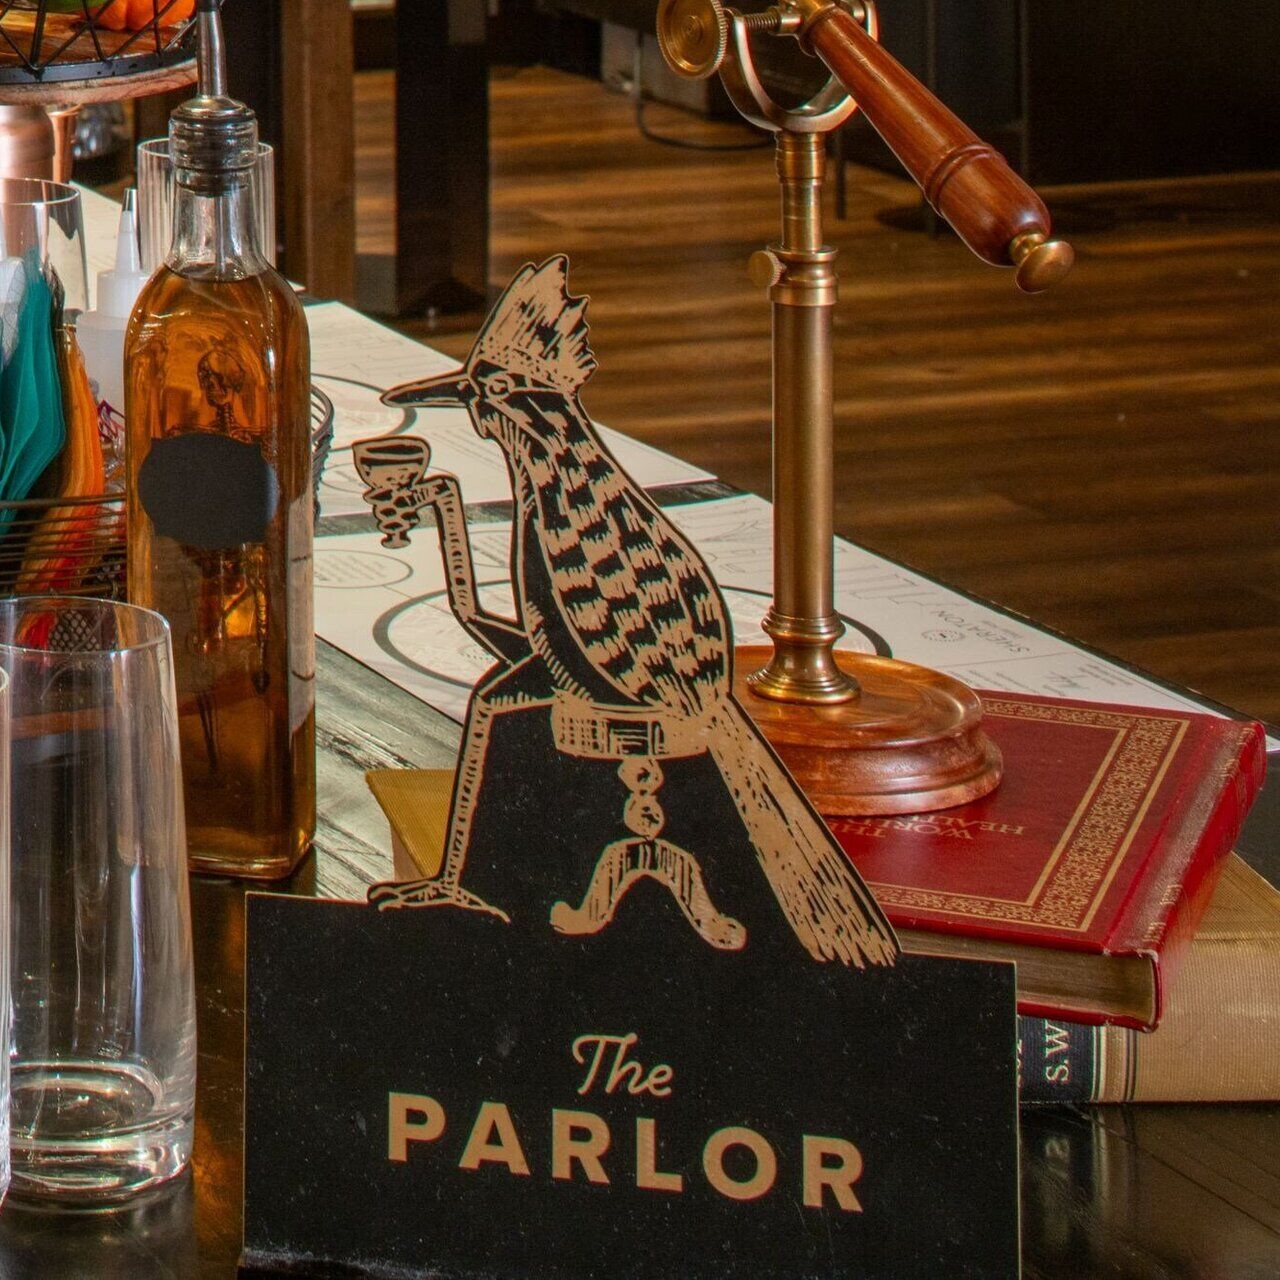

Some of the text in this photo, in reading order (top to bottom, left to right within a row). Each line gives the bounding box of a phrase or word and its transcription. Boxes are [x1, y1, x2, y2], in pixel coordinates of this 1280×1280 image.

[929, 609, 1032, 655] SHERATON
[571, 1032, 673, 1098] The
[385, 1090, 866, 1213] PARLOR
